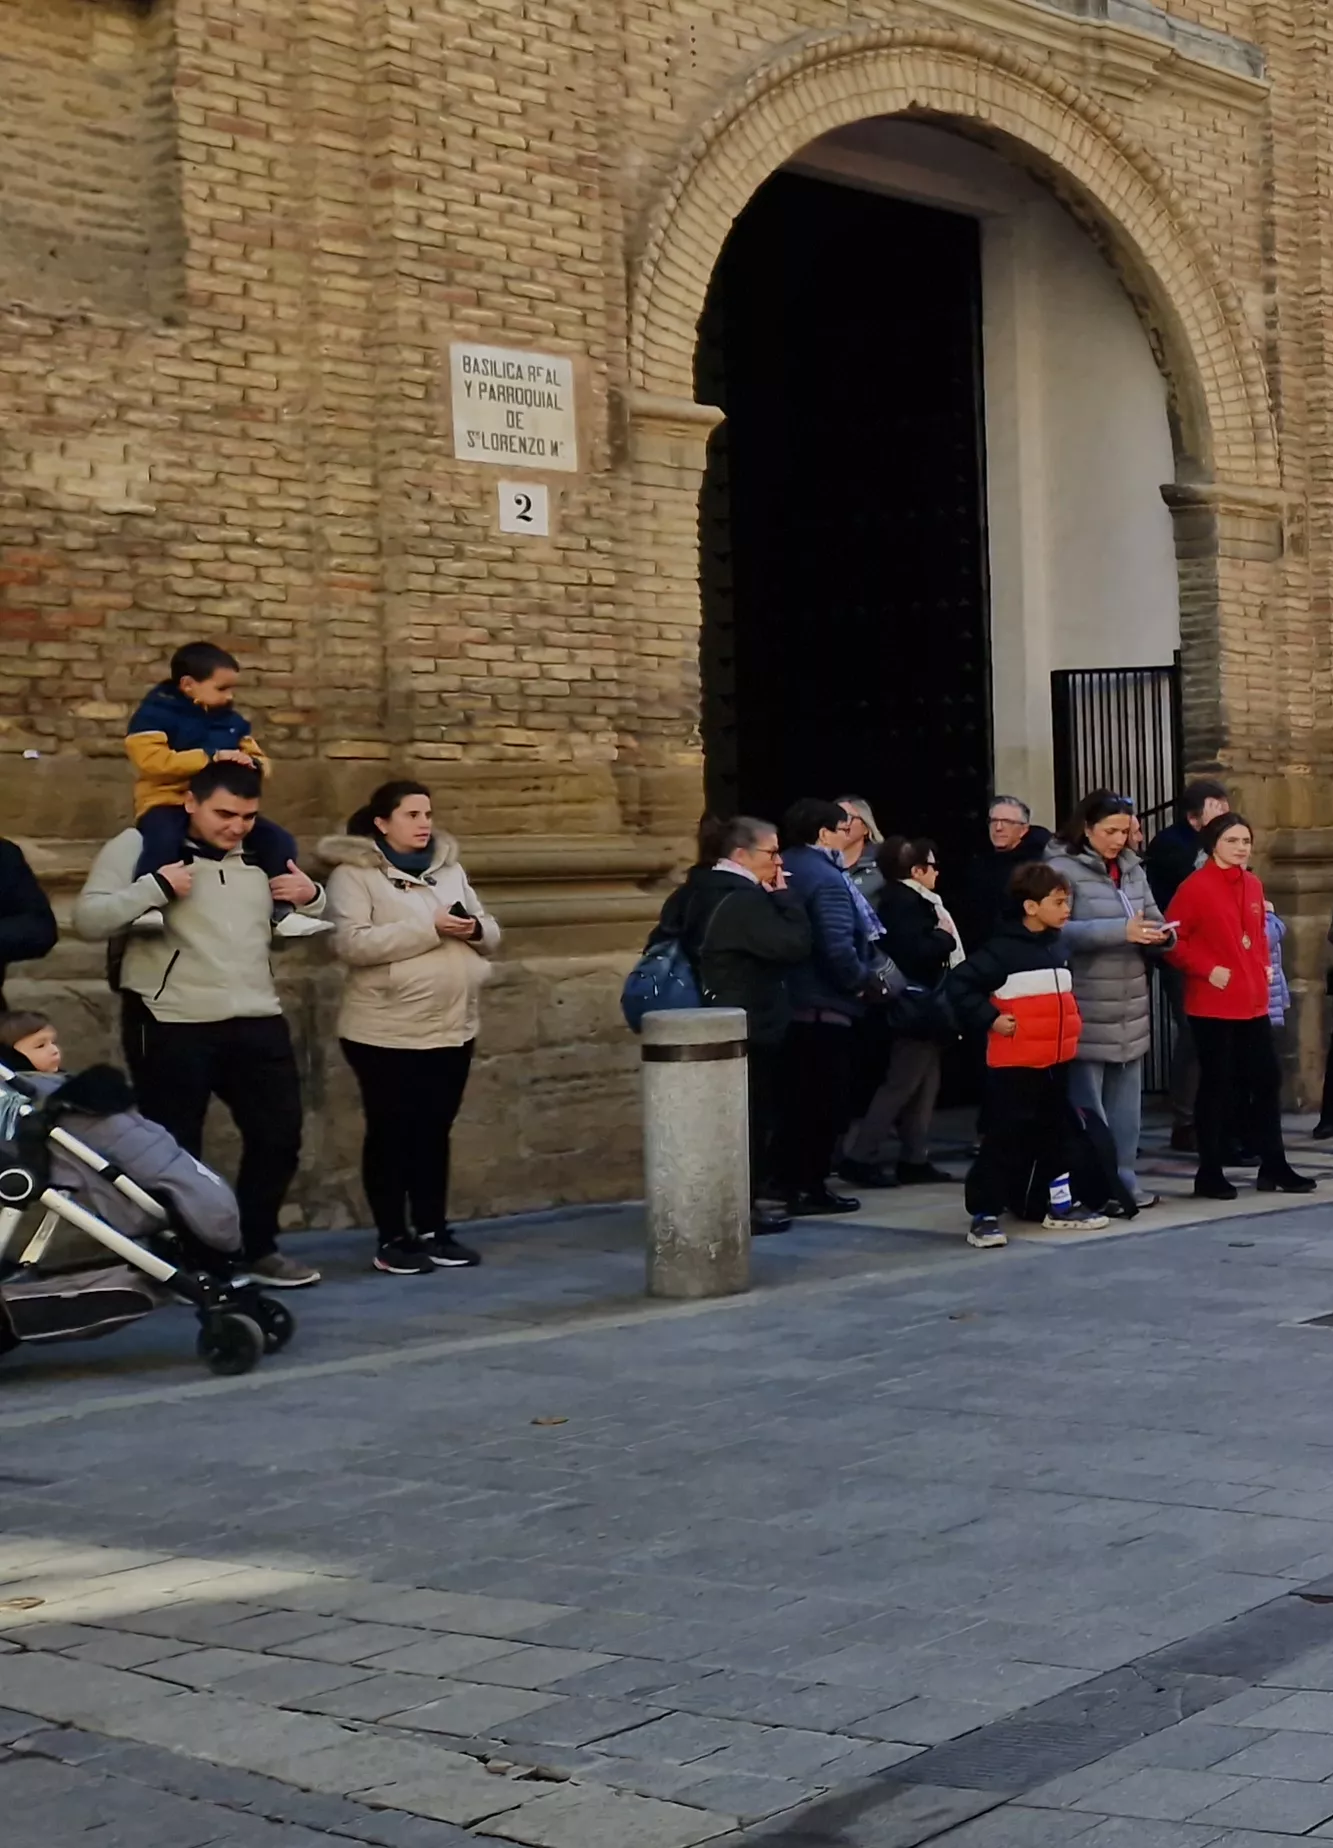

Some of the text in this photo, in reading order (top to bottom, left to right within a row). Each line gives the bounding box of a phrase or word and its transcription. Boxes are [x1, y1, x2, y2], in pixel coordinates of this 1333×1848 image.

[462, 354, 562, 387] BASILICA REAL
[464, 380, 564, 411] Y PARROQUIAL
[506, 409, 525, 430] DE
[481, 431, 546, 456] LORENZO
[513, 493, 534, 522] 2
